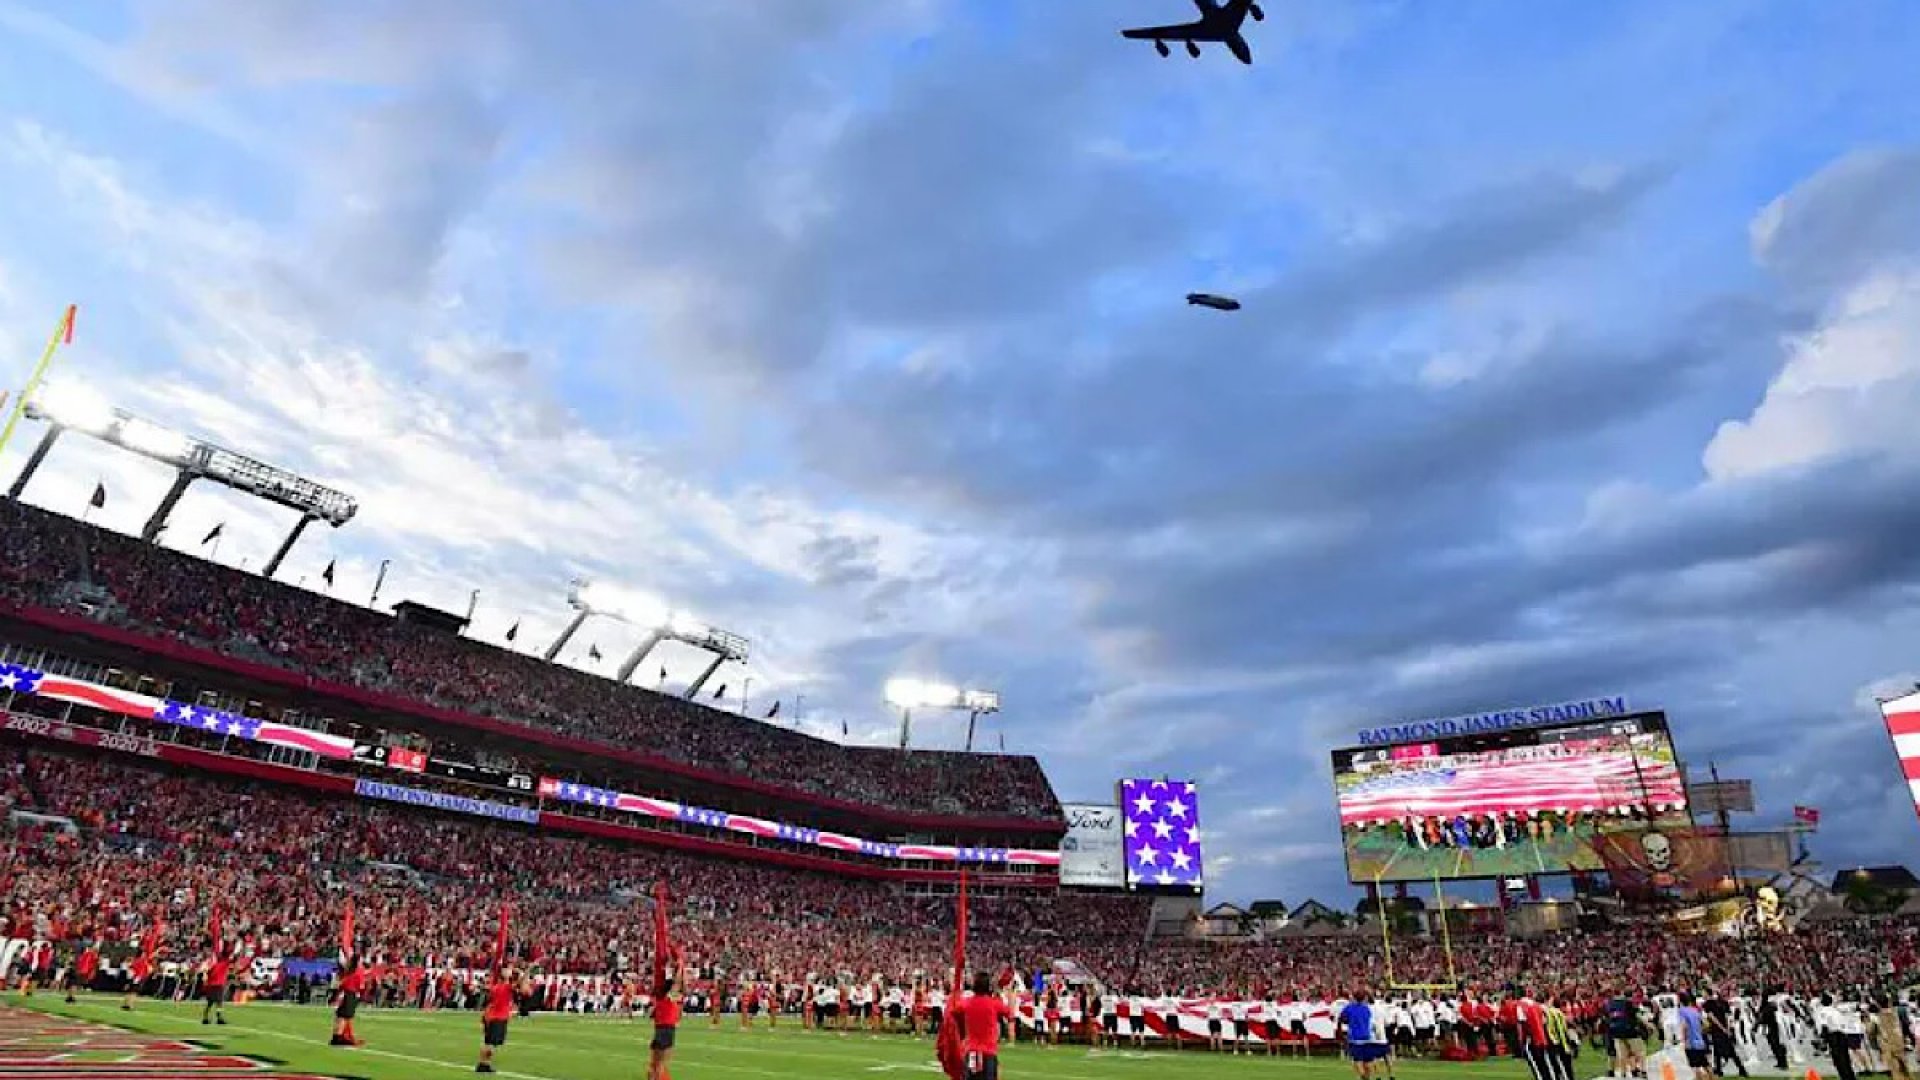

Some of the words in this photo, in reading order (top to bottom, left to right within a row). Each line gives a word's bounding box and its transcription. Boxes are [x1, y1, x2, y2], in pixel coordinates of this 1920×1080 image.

[5, 715, 50, 735] 2002
[1359, 722, 1457, 745] RAYMOND
[1460, 711, 1525, 732] JAMES
[1530, 696, 1625, 722] STADIUM
[98, 734, 138, 753] 2020
[1068, 809, 1114, 829] Ford
